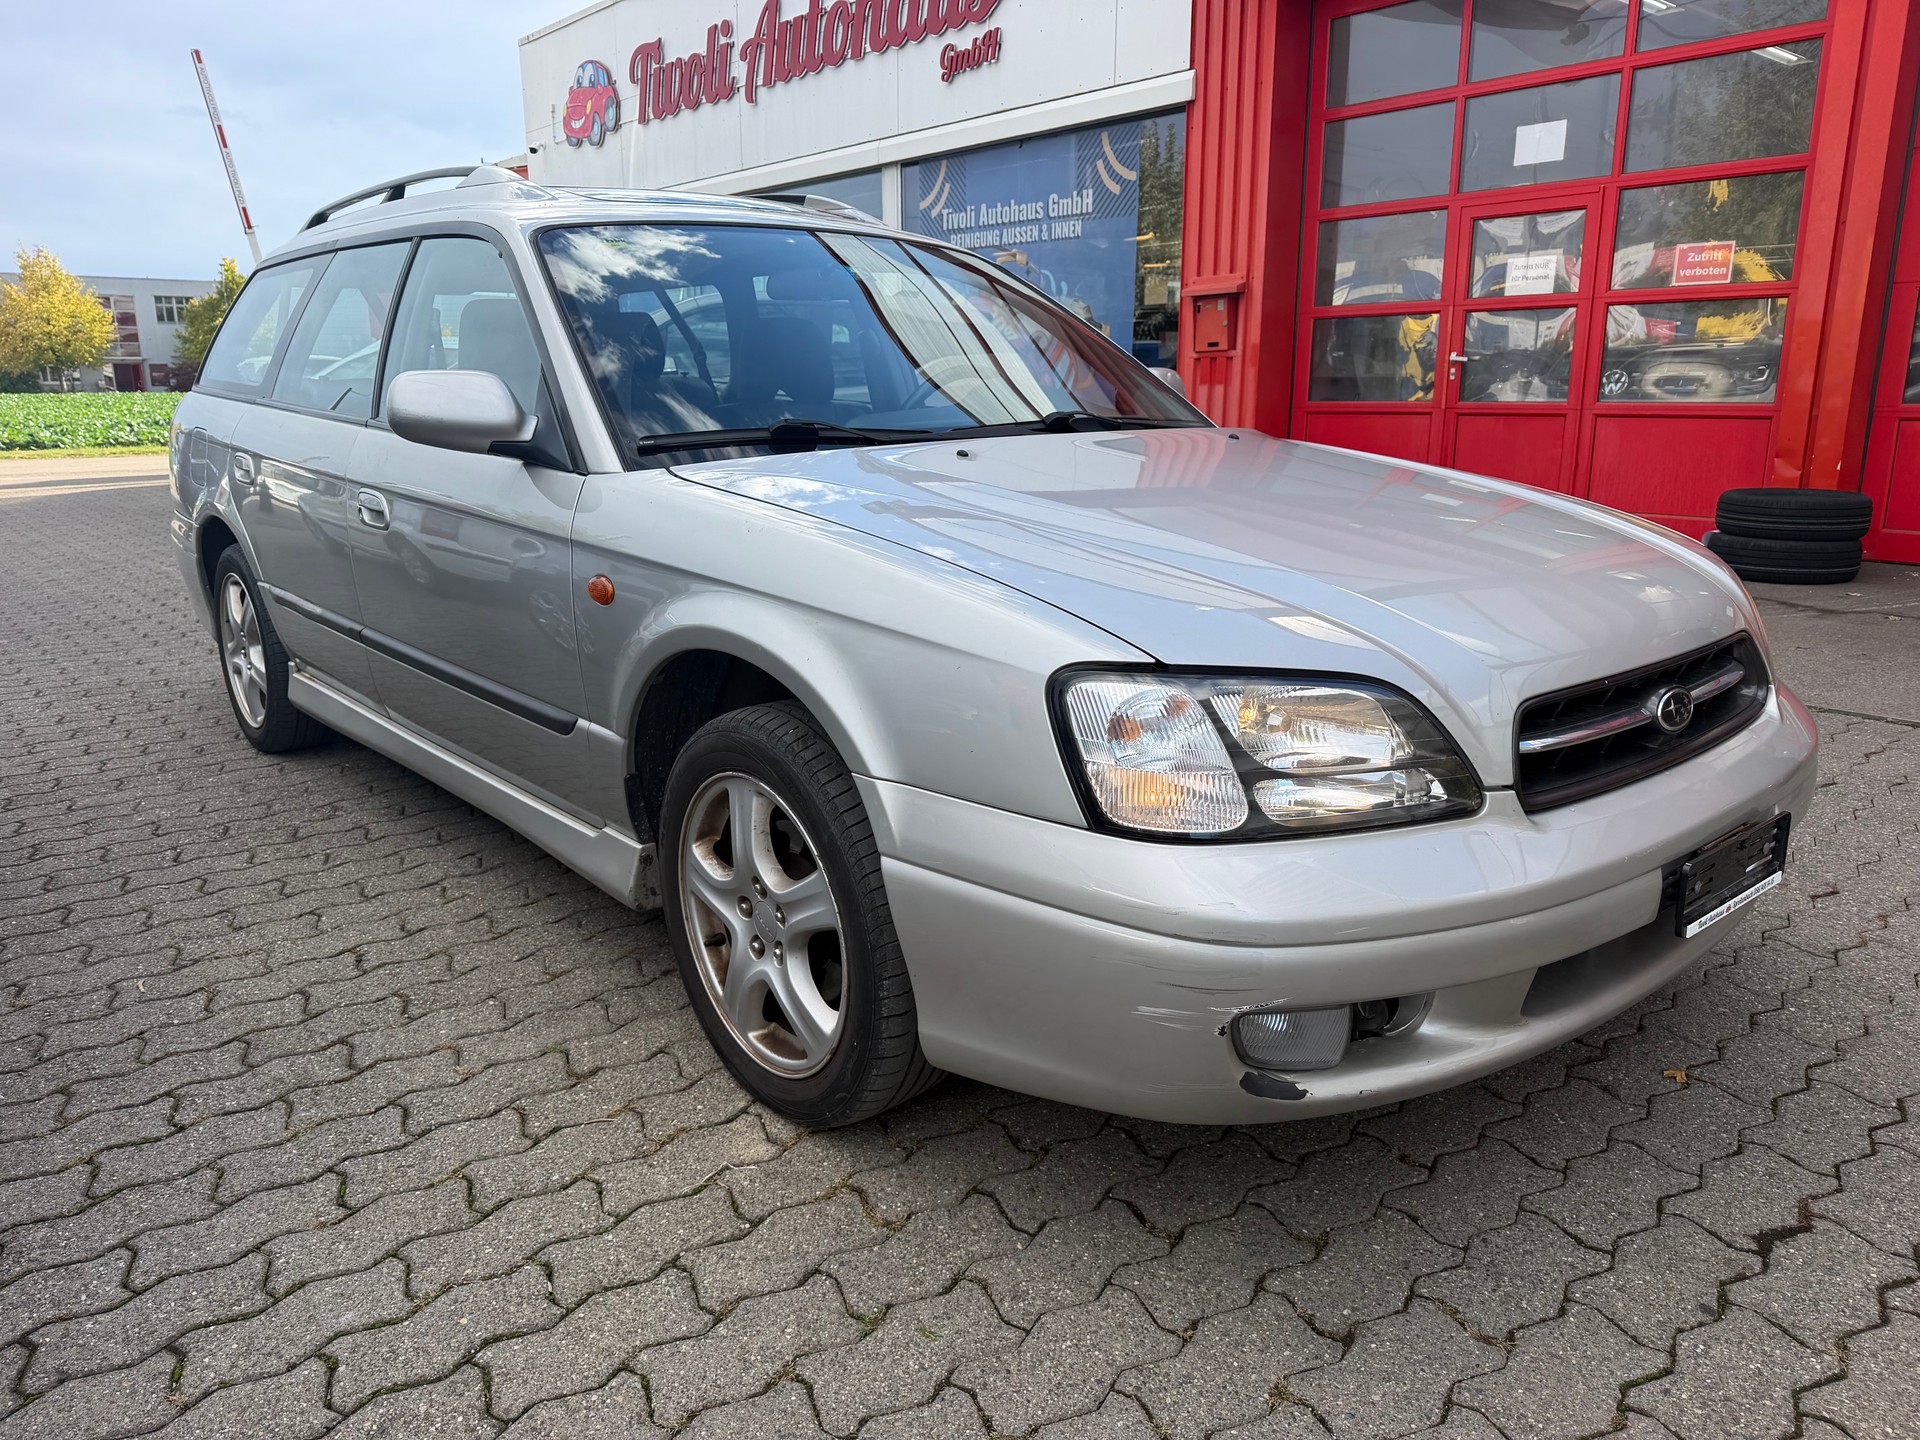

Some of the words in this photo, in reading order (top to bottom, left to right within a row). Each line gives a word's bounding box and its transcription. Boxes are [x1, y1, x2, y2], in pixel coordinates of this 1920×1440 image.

[940, 27, 1001, 83] GmbH
[200, 67, 209, 85] AUTO
[629, 19, 736, 125] Tivoli
[225, 151, 233, 169] AUTO
[941, 205, 976, 231] Tivoli
[979, 200, 1044, 226] Autohaus
[1048, 188, 1094, 218] GmbH
[1001, 225, 1039, 246] AUSSEN
[1041, 223, 1049, 241] &
[1051, 219, 1082, 240] INNEN
[1686, 251, 1723, 262] Zutritt
[1679, 266, 1727, 277] verboten
